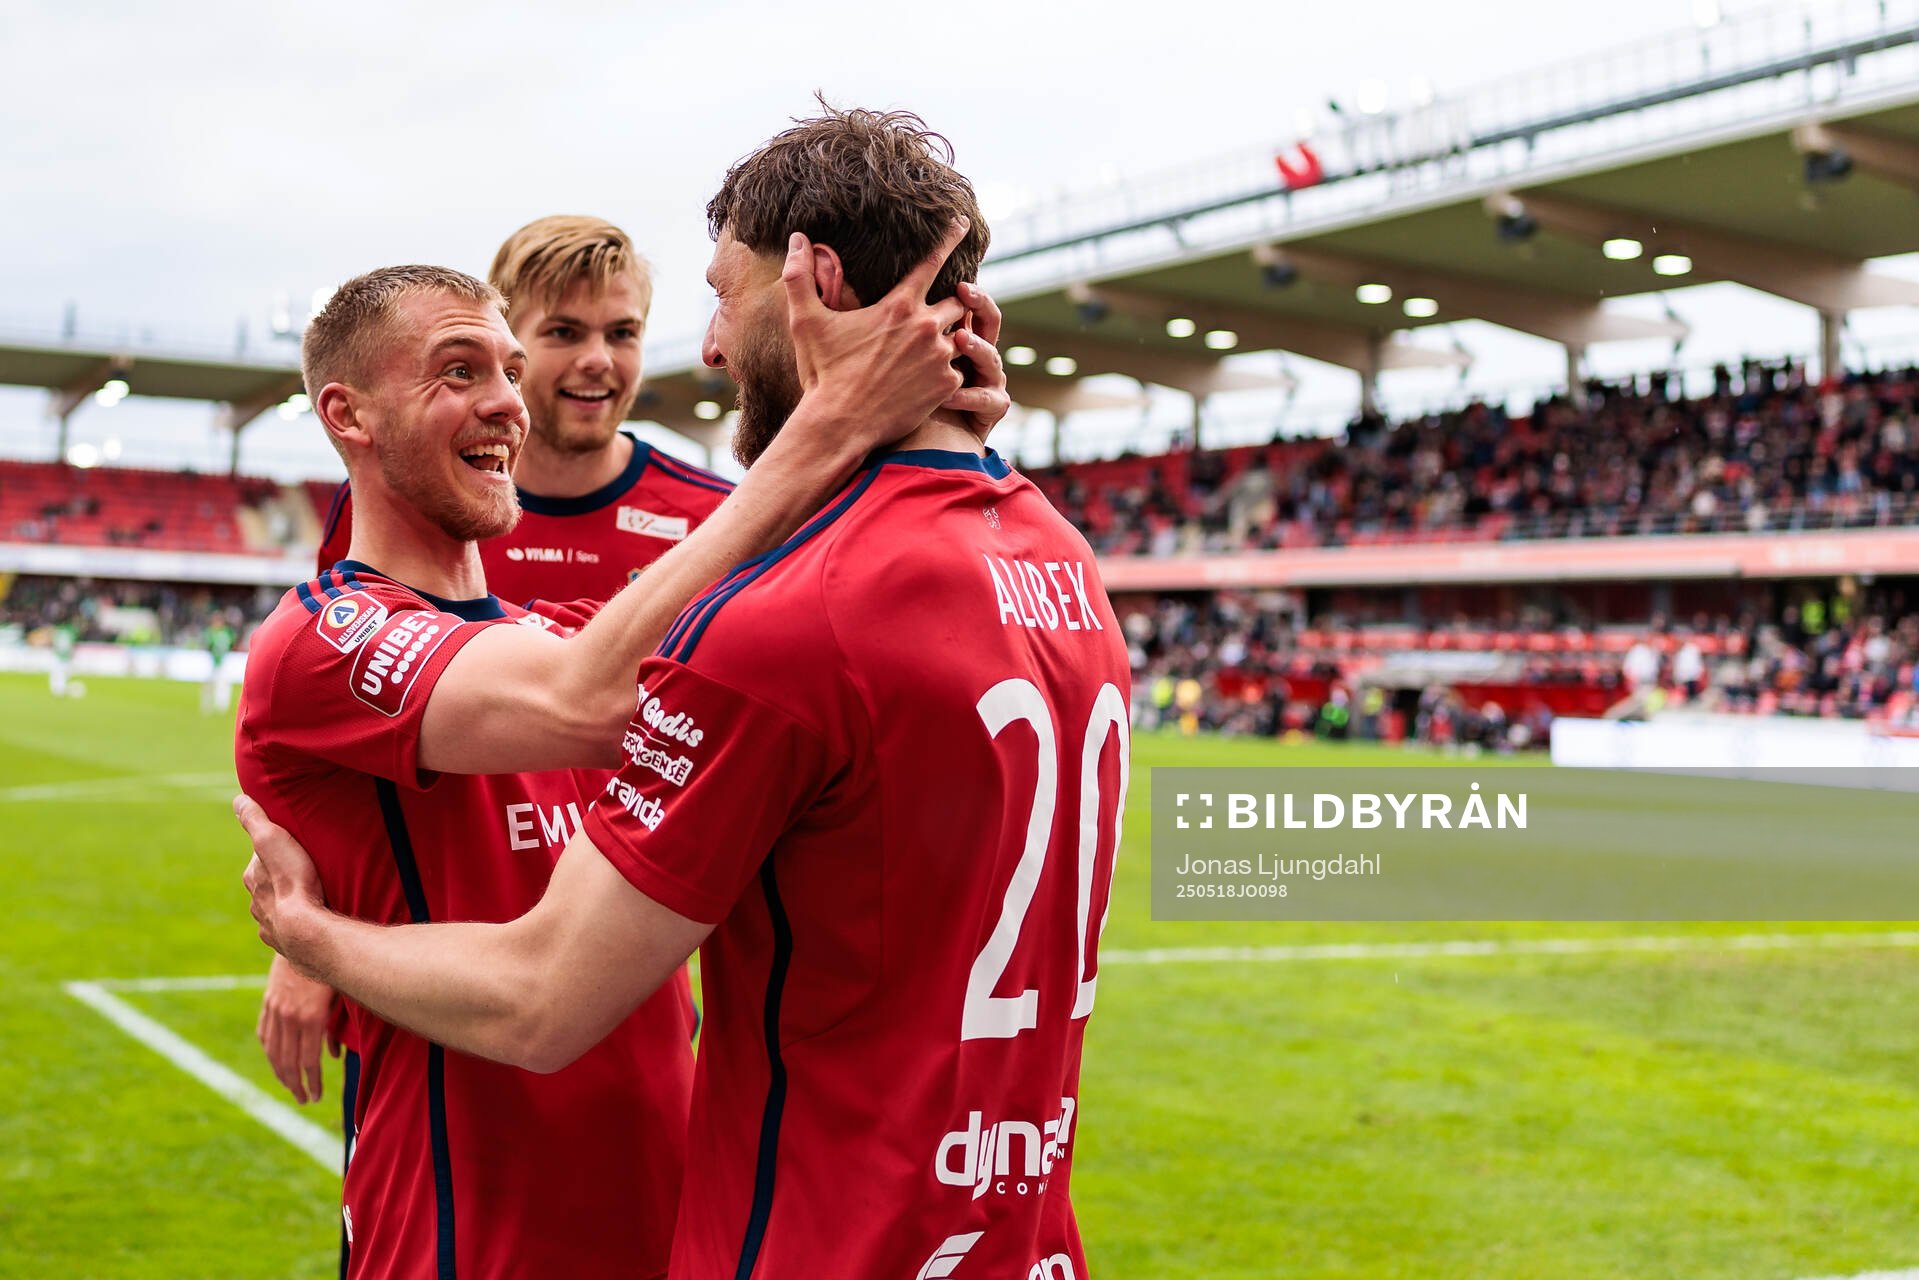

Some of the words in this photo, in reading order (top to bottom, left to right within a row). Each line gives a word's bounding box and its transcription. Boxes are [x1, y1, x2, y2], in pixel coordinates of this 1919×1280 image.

[338, 605, 377, 644] ALLSVENSKAN
[354, 620, 377, 643] UNIBET
[361, 611, 439, 696] UNIBET
[643, 697, 704, 747] Godis
[506, 800, 597, 850] EMI
[606, 777, 665, 832] ravida
[961, 678, 1130, 1041] 20
